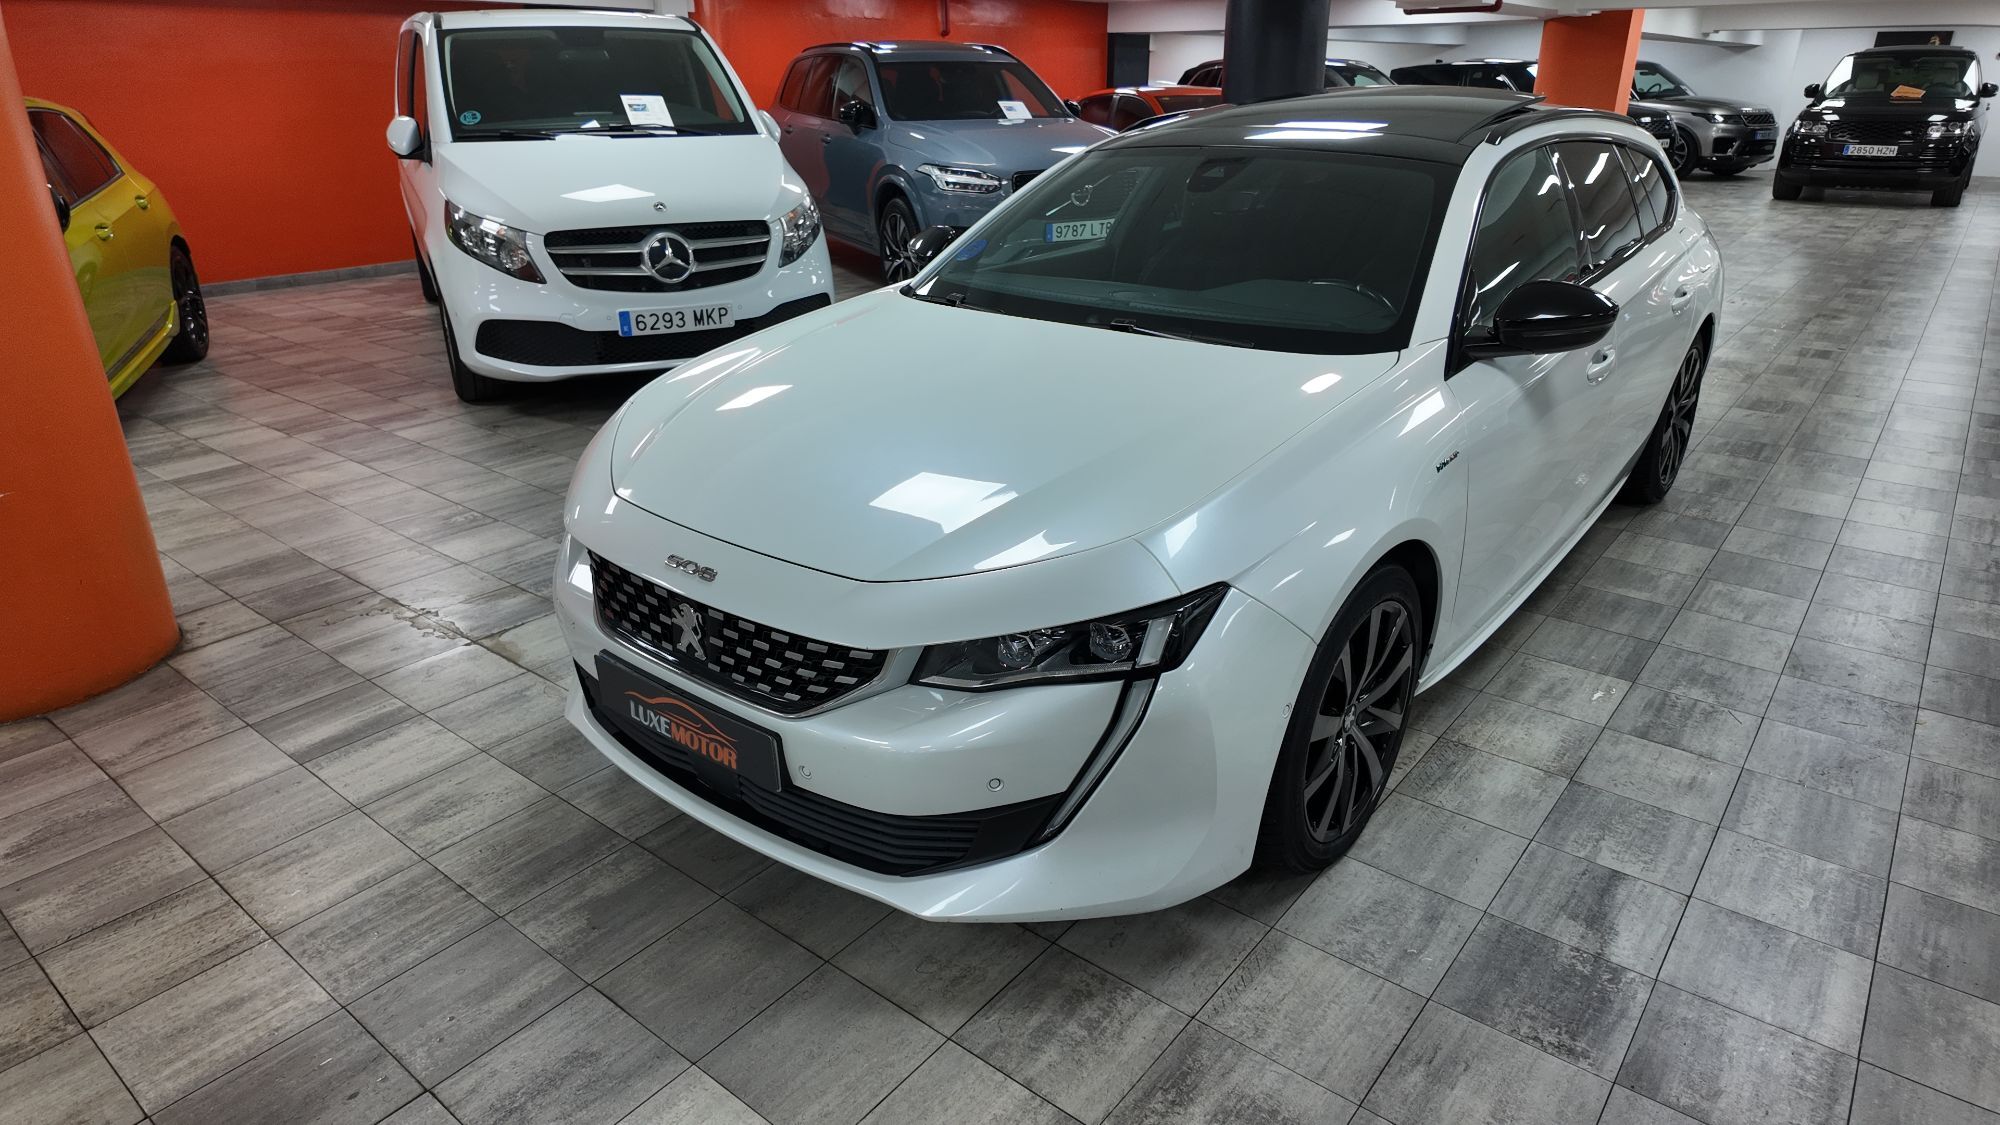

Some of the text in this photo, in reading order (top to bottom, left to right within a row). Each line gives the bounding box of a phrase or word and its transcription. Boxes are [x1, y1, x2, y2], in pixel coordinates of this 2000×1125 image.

[1850, 146, 1896, 155] 2850 HZH
[1055, 224, 1087, 239] 9787
[635, 307, 728, 332] 6293 MKP
[665, 553, 718, 583] 508
[629, 700, 737, 770] LUXEMOTOR
